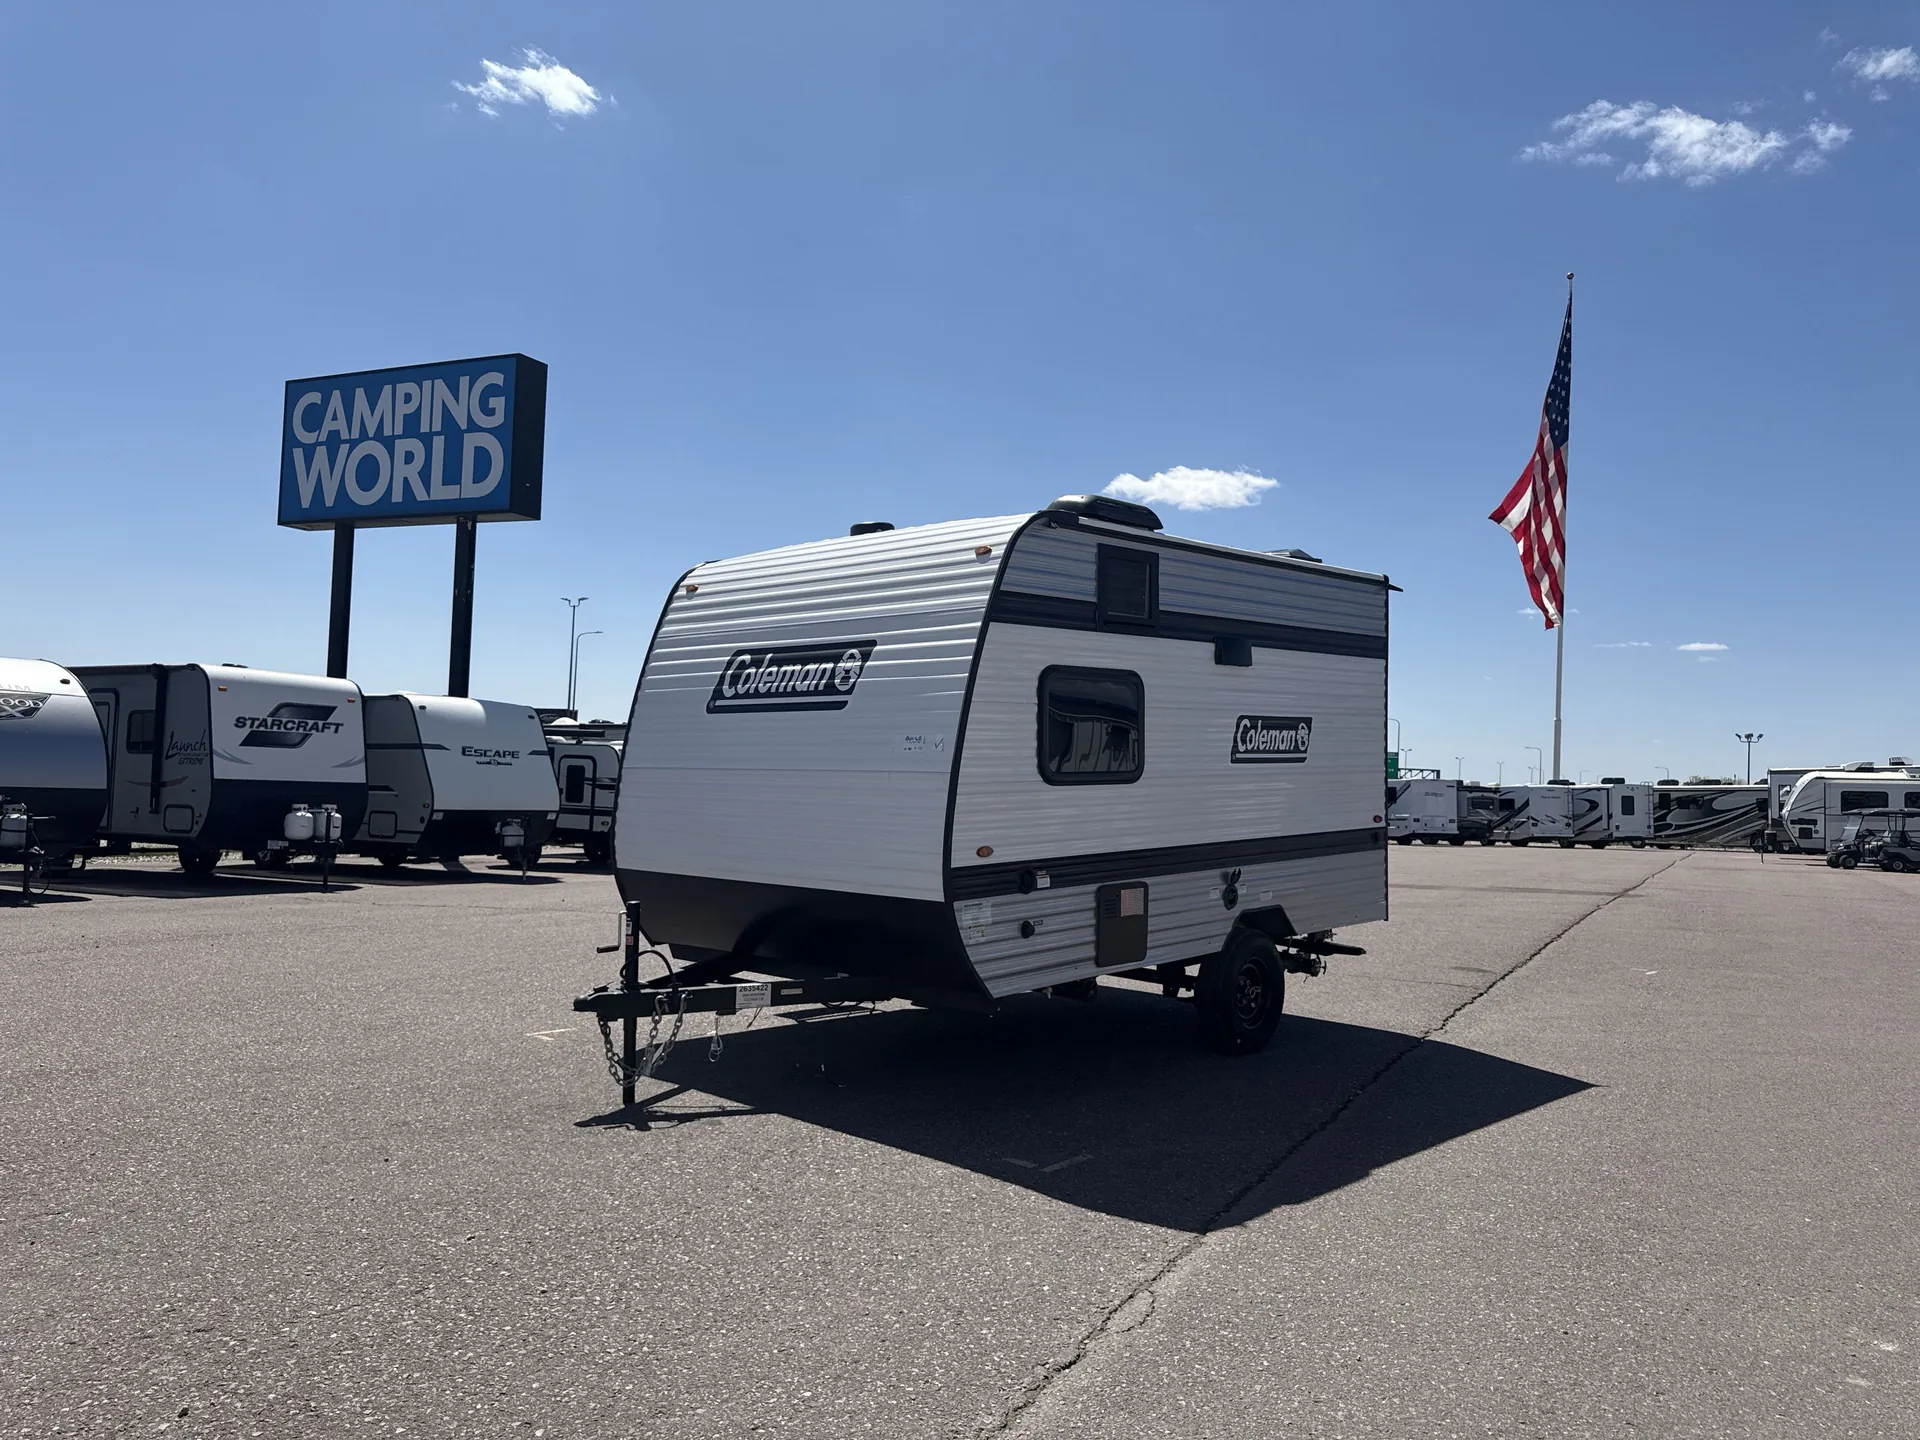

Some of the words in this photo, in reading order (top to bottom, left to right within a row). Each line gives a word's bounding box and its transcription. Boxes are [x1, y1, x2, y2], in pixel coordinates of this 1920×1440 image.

[292, 371, 506, 444] CAMPING
[292, 431, 505, 509] WORLD
[722, 652, 834, 698] Coleman
[234, 716, 344, 734] STARCRAFT
[1237, 718, 1296, 752] Coleman
[165, 729, 207, 760] Launch
[739, 985, 769, 993] 2635422
